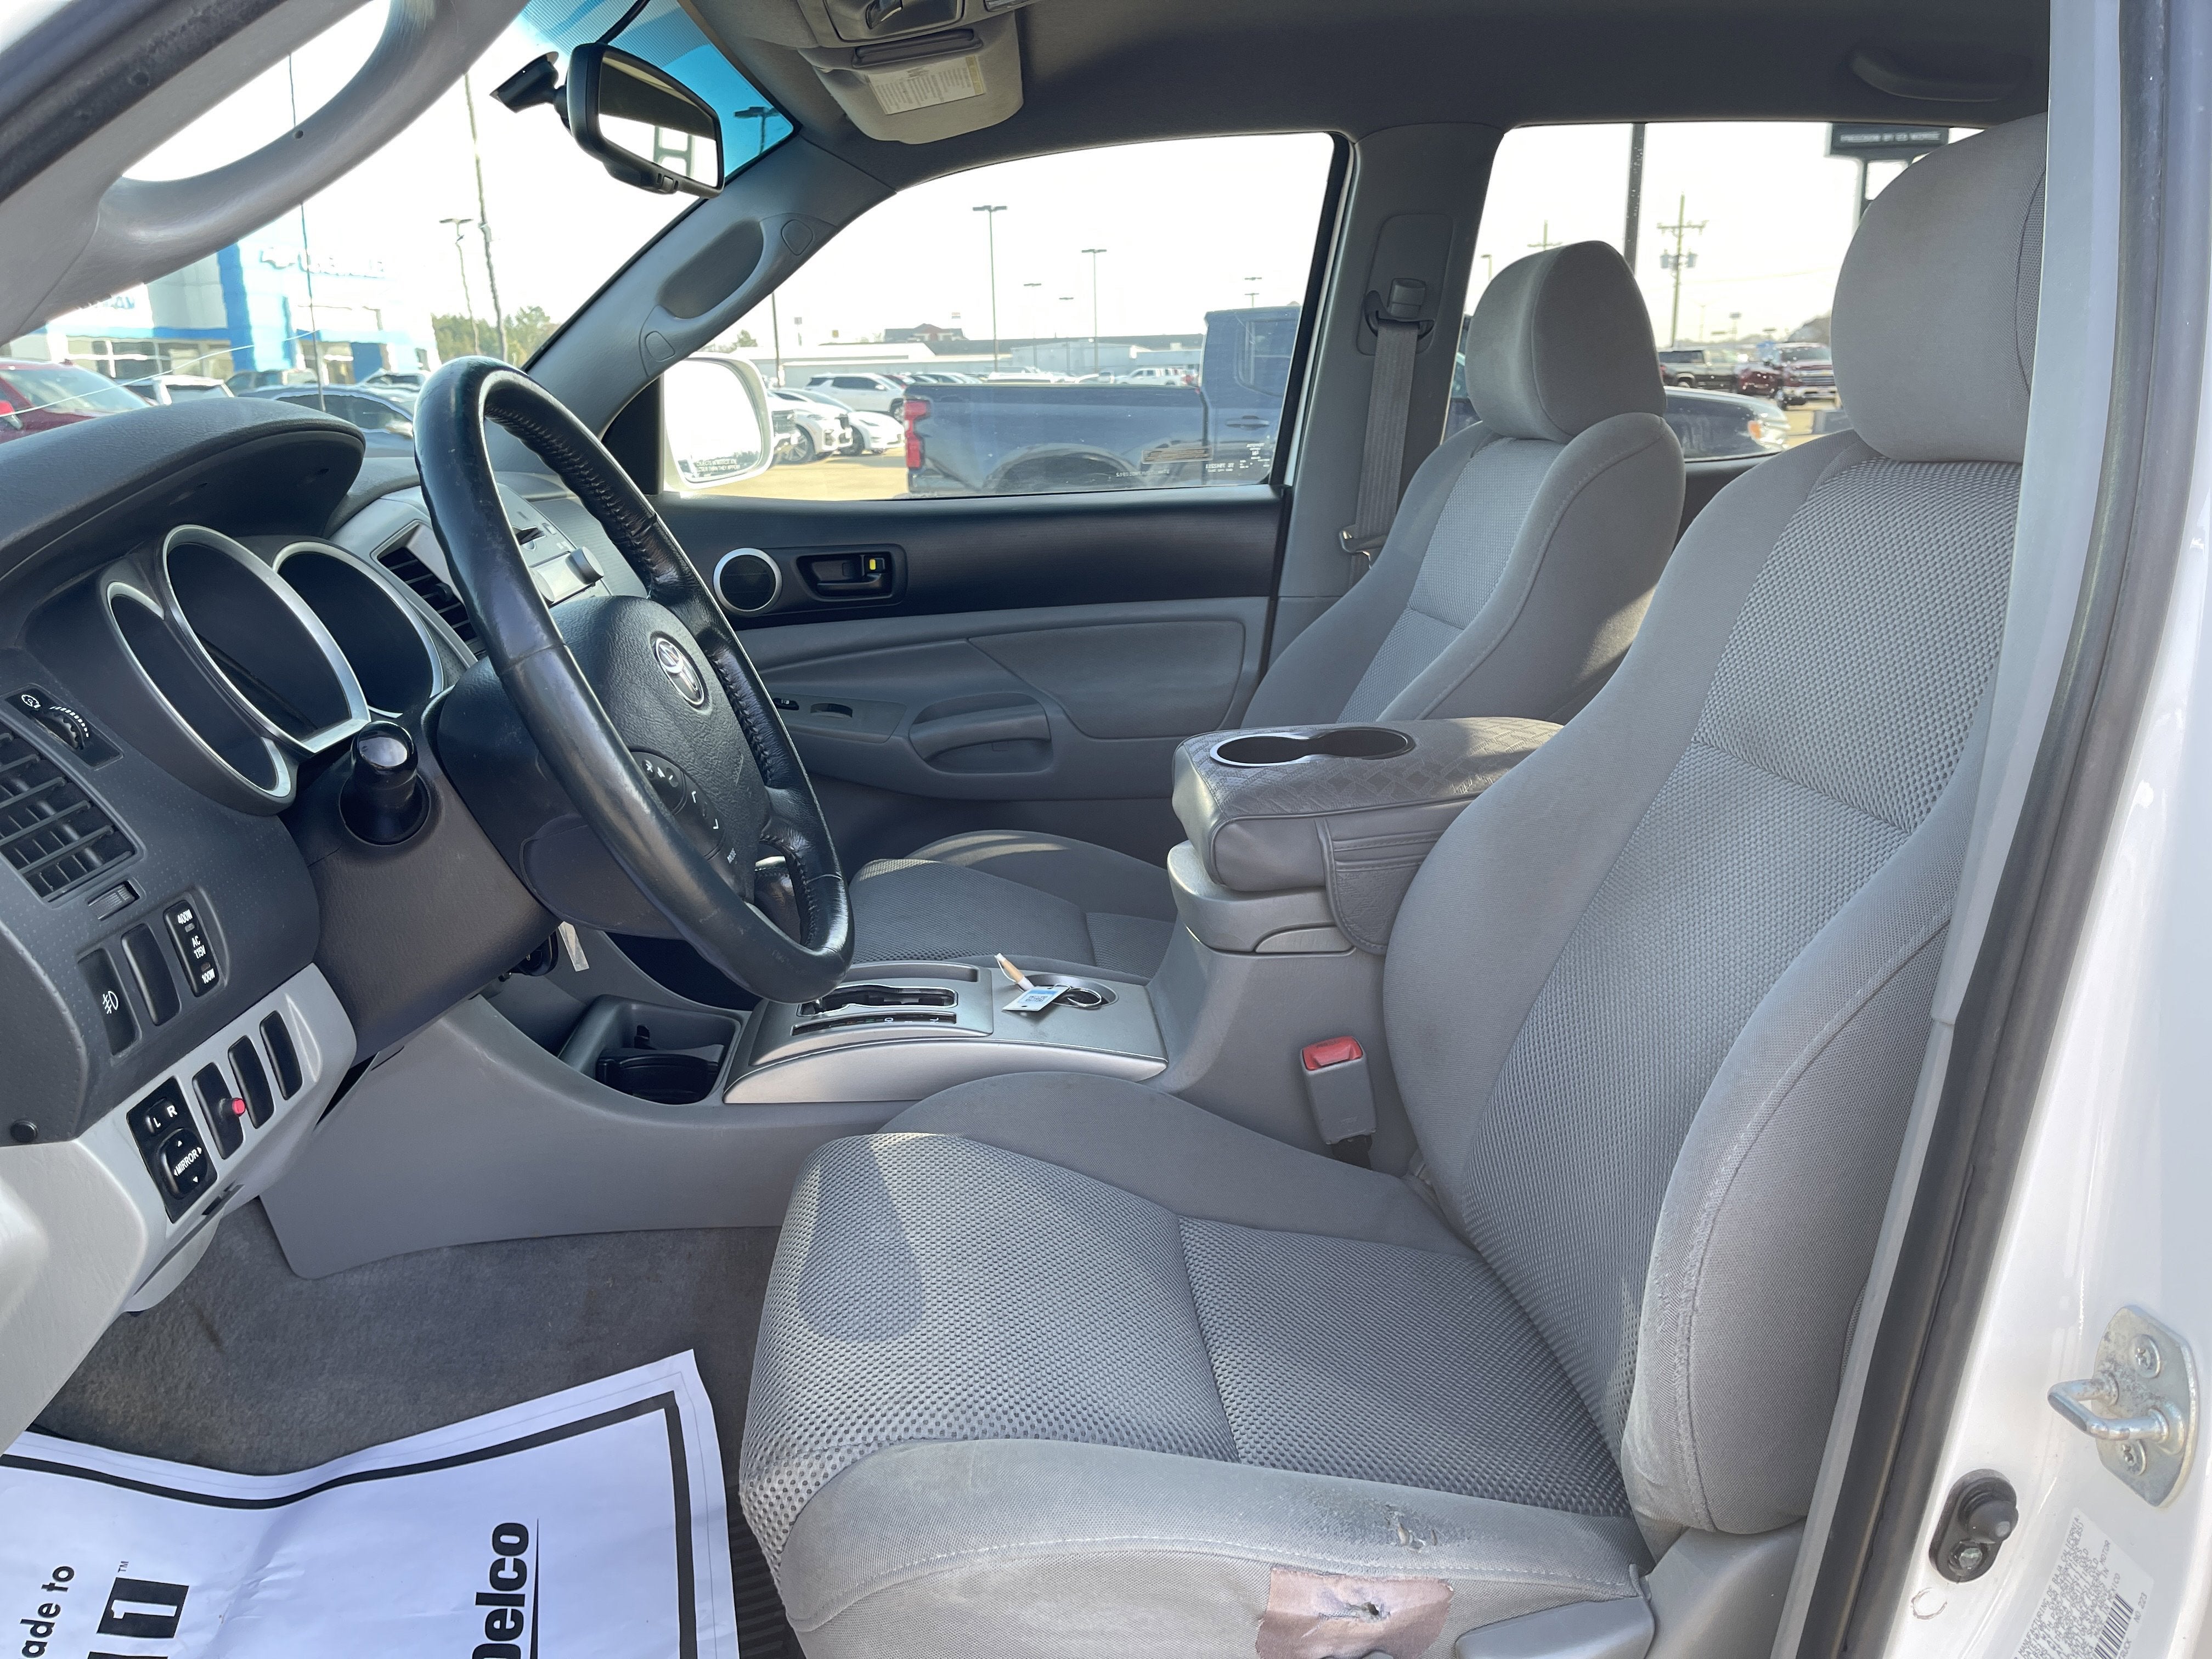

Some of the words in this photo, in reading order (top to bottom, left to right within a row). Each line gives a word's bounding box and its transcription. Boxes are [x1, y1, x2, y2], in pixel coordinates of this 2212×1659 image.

[177, 909, 193, 924] 400W
[191, 935, 201, 948] AC
[194, 945, 206, 959] 115V
[201, 968, 216, 984] 100W
[153, 1118, 161, 1128] L
[167, 1105, 178, 1118] R
[176, 1149, 199, 1175] MIRROR
[2098, 1539, 2111, 1565] MOTOR
[20, 1602, 61, 1658] ade
[41, 1566, 75, 1592] to
[2017, 1598, 2049, 1657] MANUFACTURING
[2046, 1584, 2055, 1597] DE
[2052, 1564, 2063, 1584] BAJA
[2133, 1610, 2141, 1623] NO
[2138, 1592, 2147, 1610] 223
